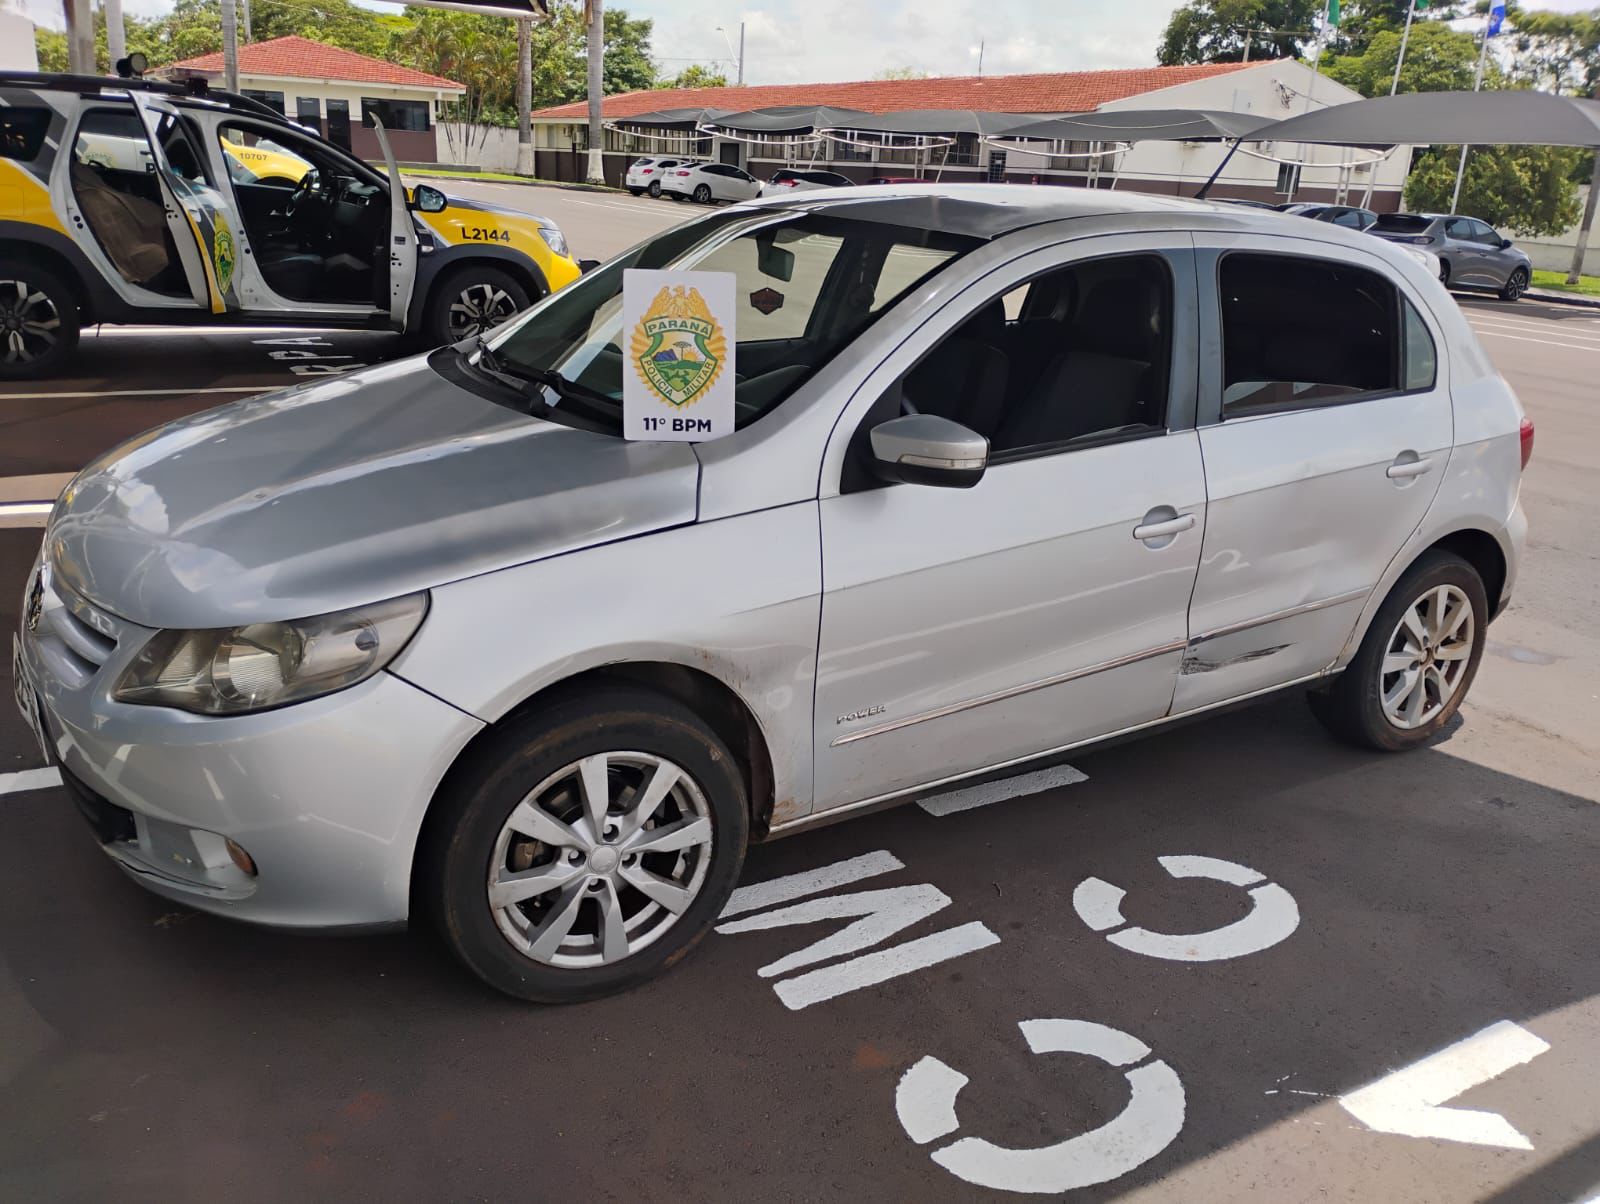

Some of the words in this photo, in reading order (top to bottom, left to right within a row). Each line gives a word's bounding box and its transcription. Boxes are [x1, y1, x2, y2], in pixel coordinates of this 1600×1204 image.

[240, 152, 268, 161] 10707
[461, 226, 511, 242] L2144
[647, 320, 710, 335] PARANÁ
[683, 361, 713, 397] MILITAR
[672, 418, 712, 433] BPM
[836, 704, 886, 725] POWER
